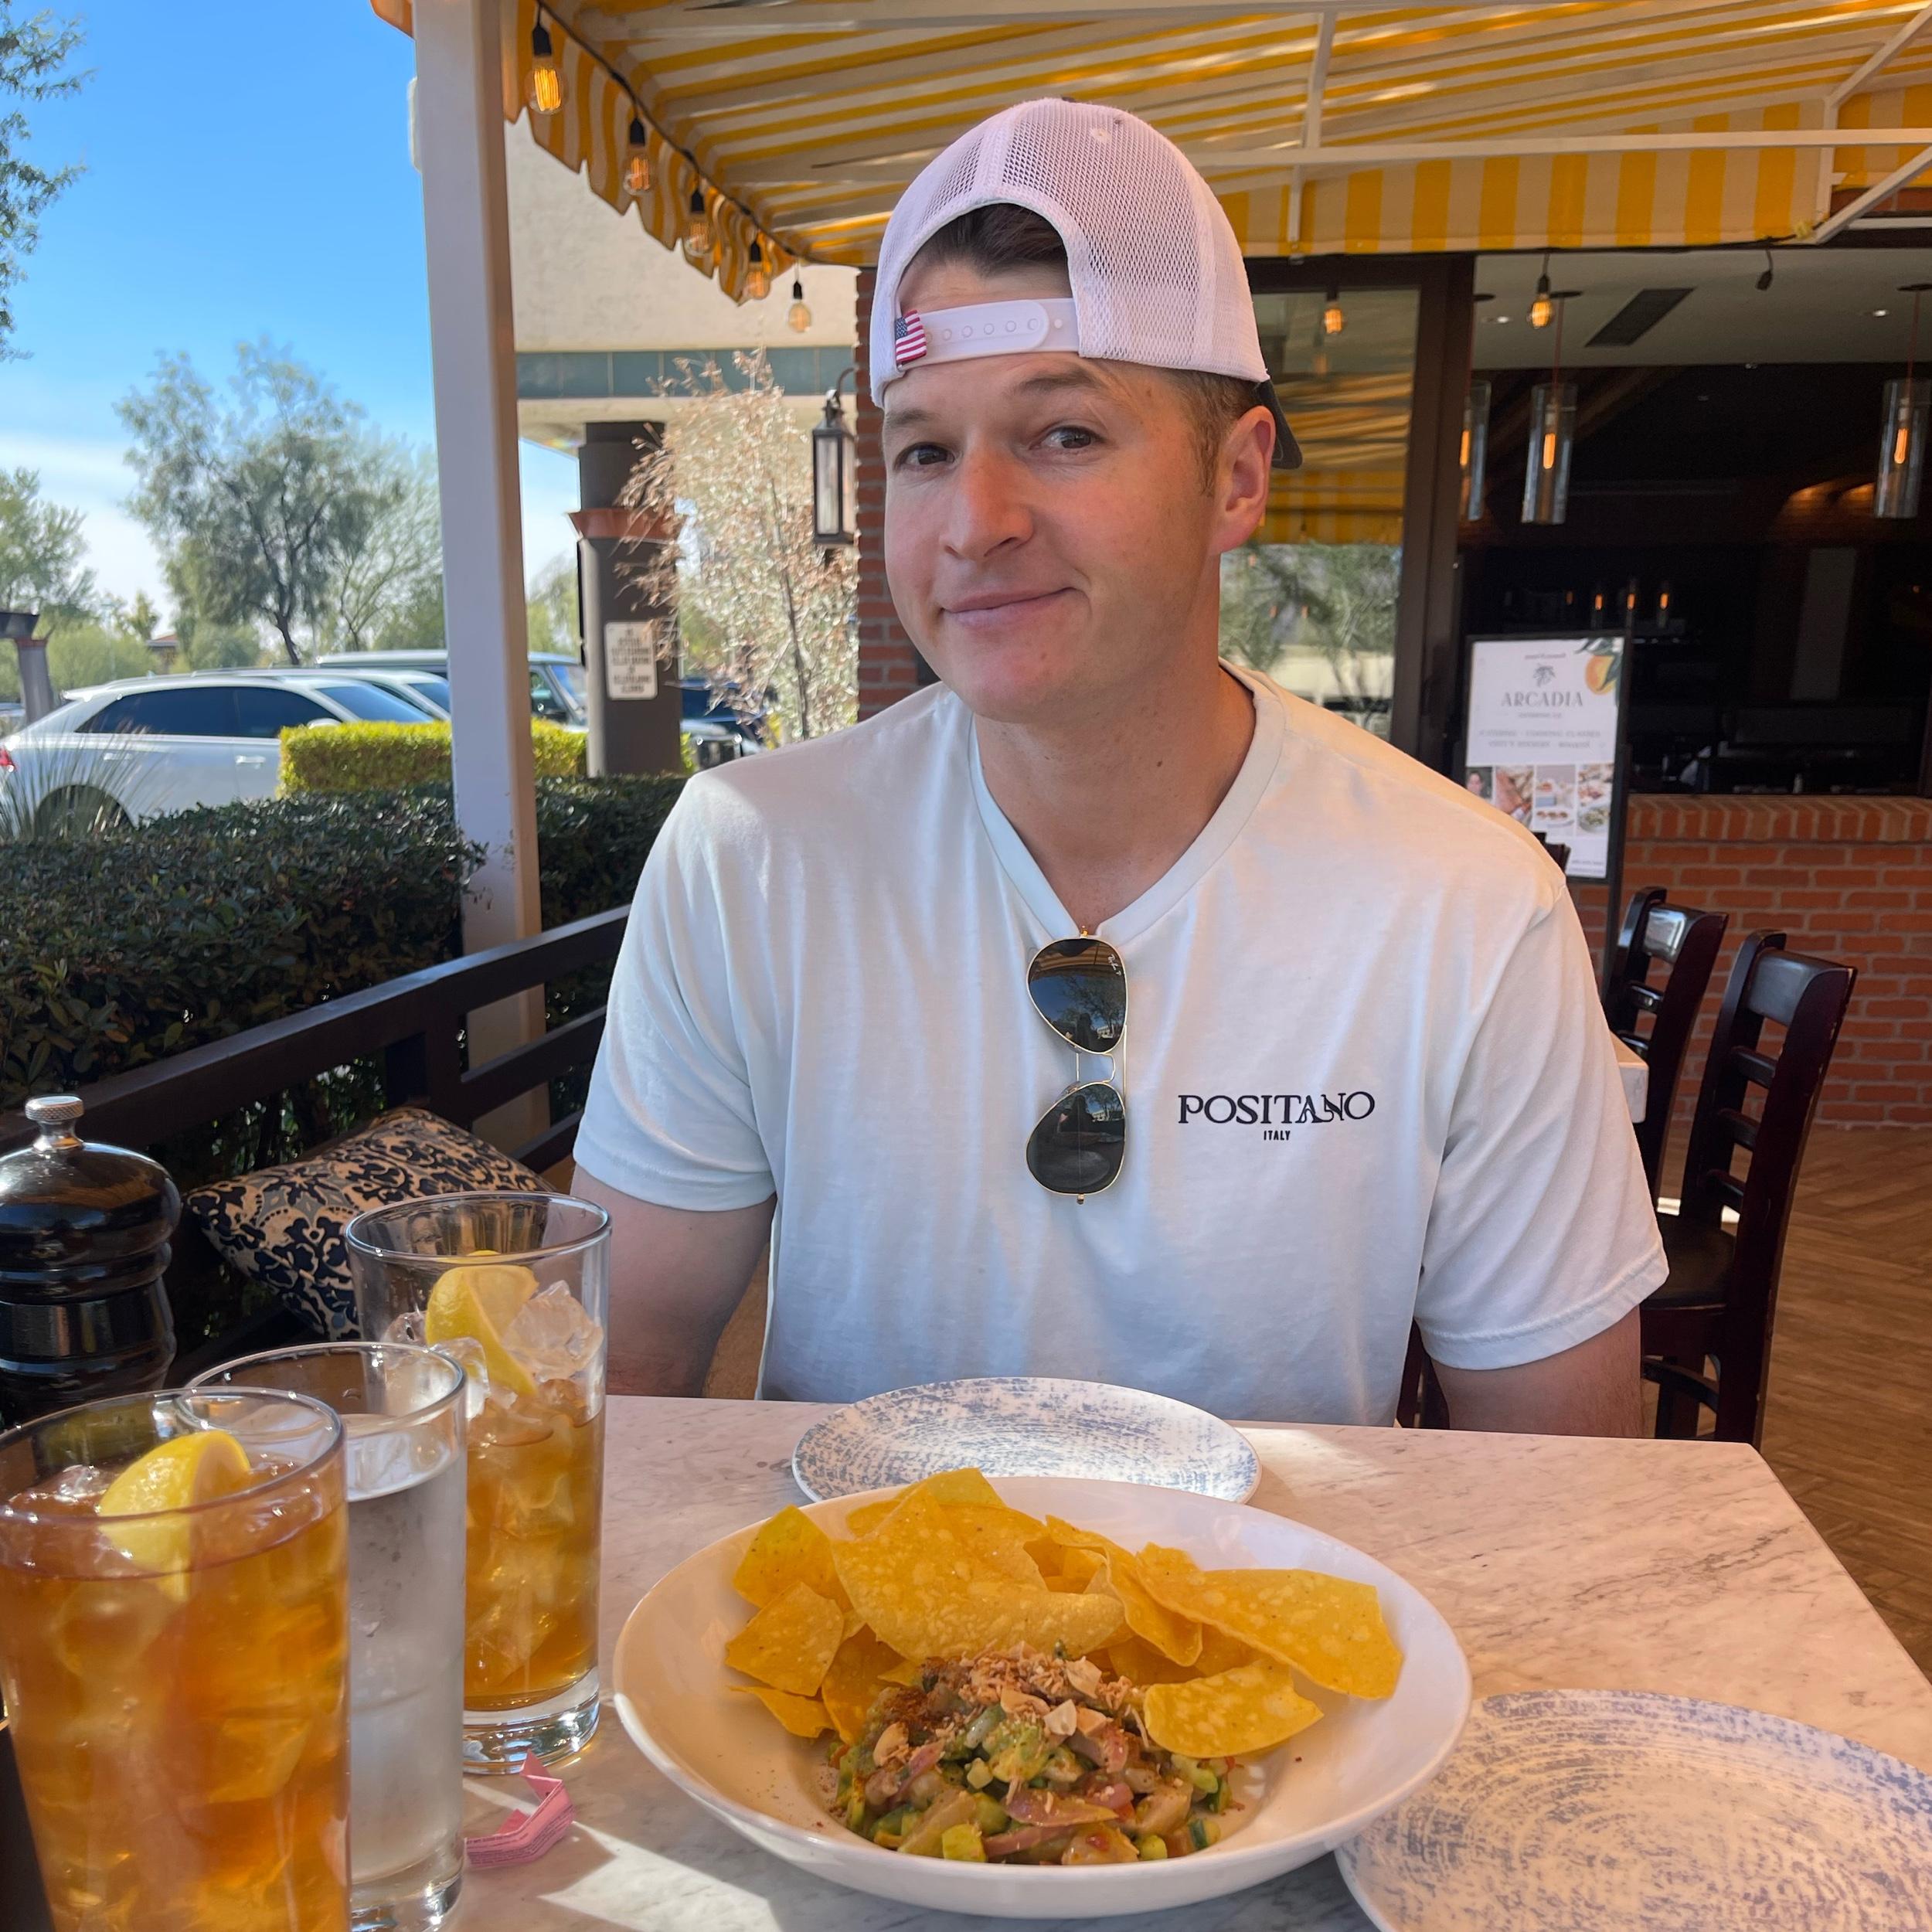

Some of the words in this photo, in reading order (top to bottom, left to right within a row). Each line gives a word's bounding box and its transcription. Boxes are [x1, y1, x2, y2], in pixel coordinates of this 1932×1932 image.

[1501, 691, 1583, 707] ARCADIA
[1178, 1091, 1375, 1124] POSITANO
[1264, 1130, 1291, 1141] ITALY
